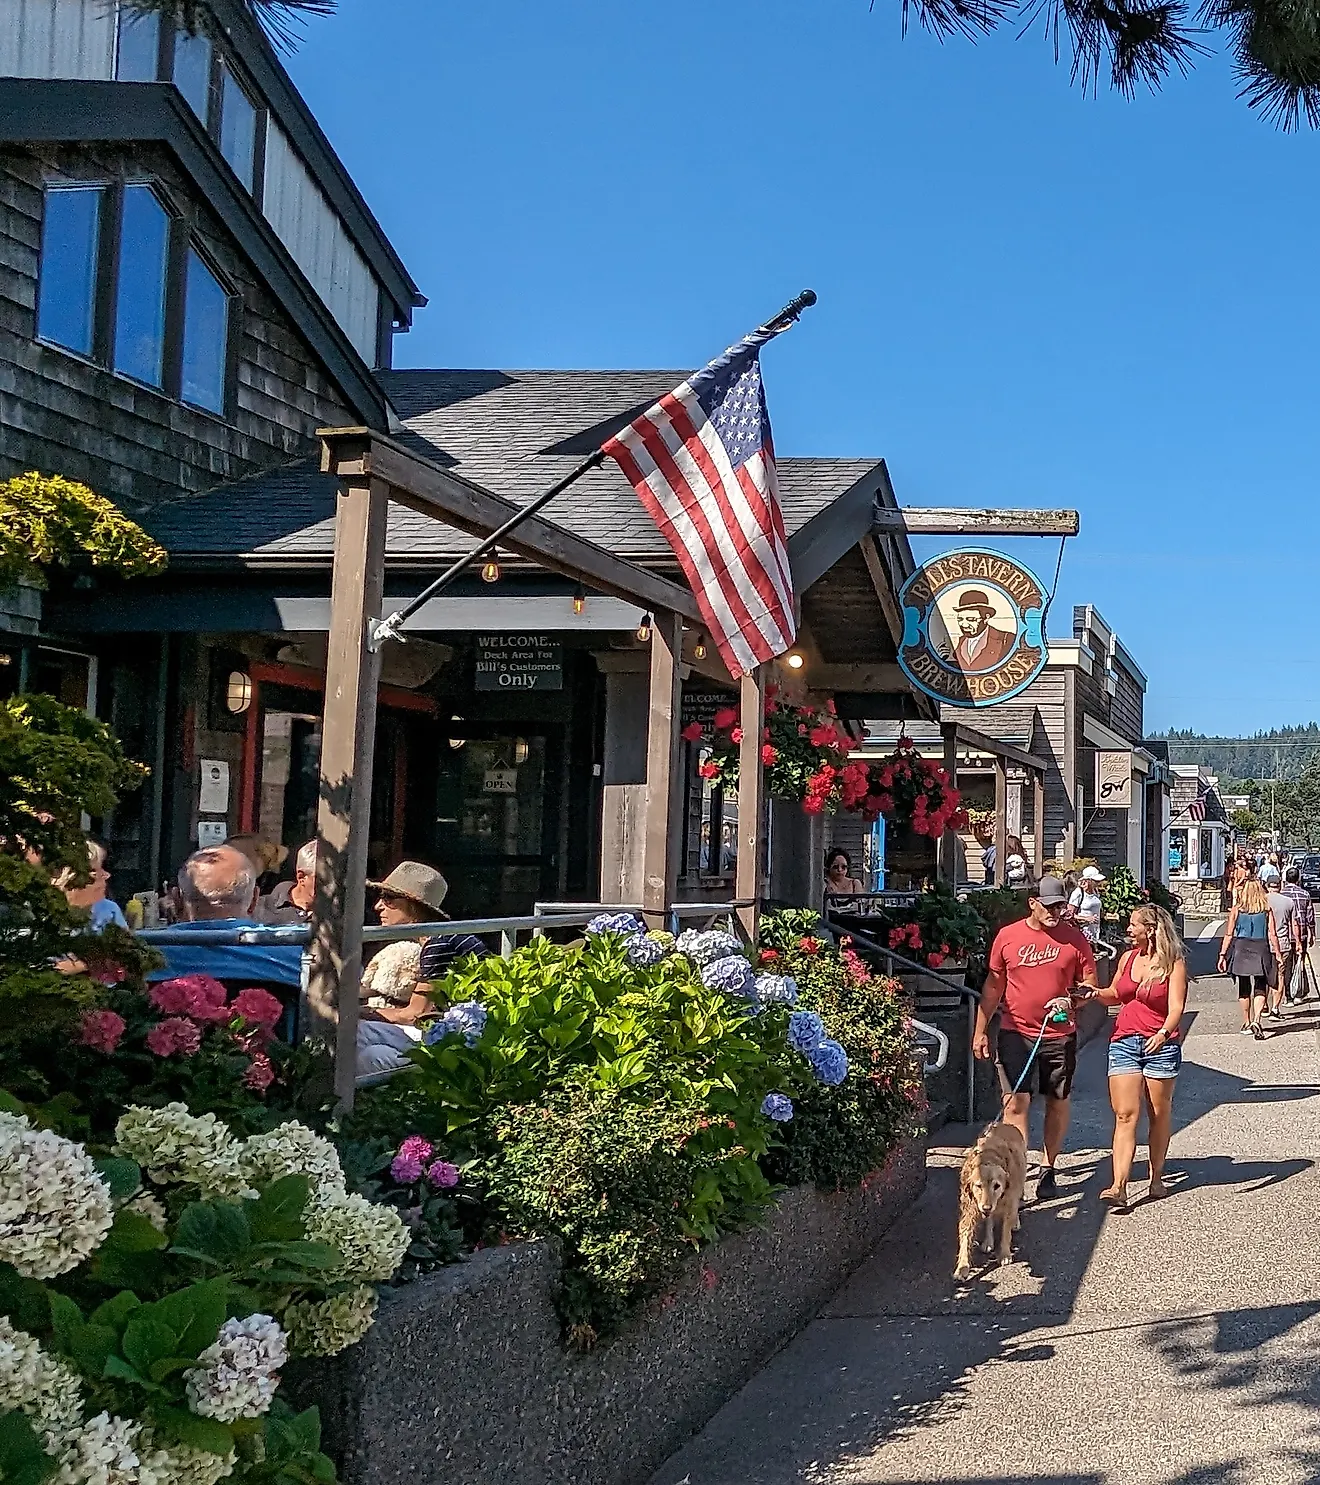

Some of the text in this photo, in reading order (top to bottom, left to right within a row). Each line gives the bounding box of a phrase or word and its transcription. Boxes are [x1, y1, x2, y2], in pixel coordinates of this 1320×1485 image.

[910, 555, 1036, 602] BILL'S TAVERN
[484, 651, 508, 659] Deck
[511, 651, 534, 659] Area
[476, 660, 561, 672] Bill's Customers
[498, 673, 538, 689] Only
[485, 780, 513, 789] OPEN
[1017, 943, 1061, 967] Lucky
